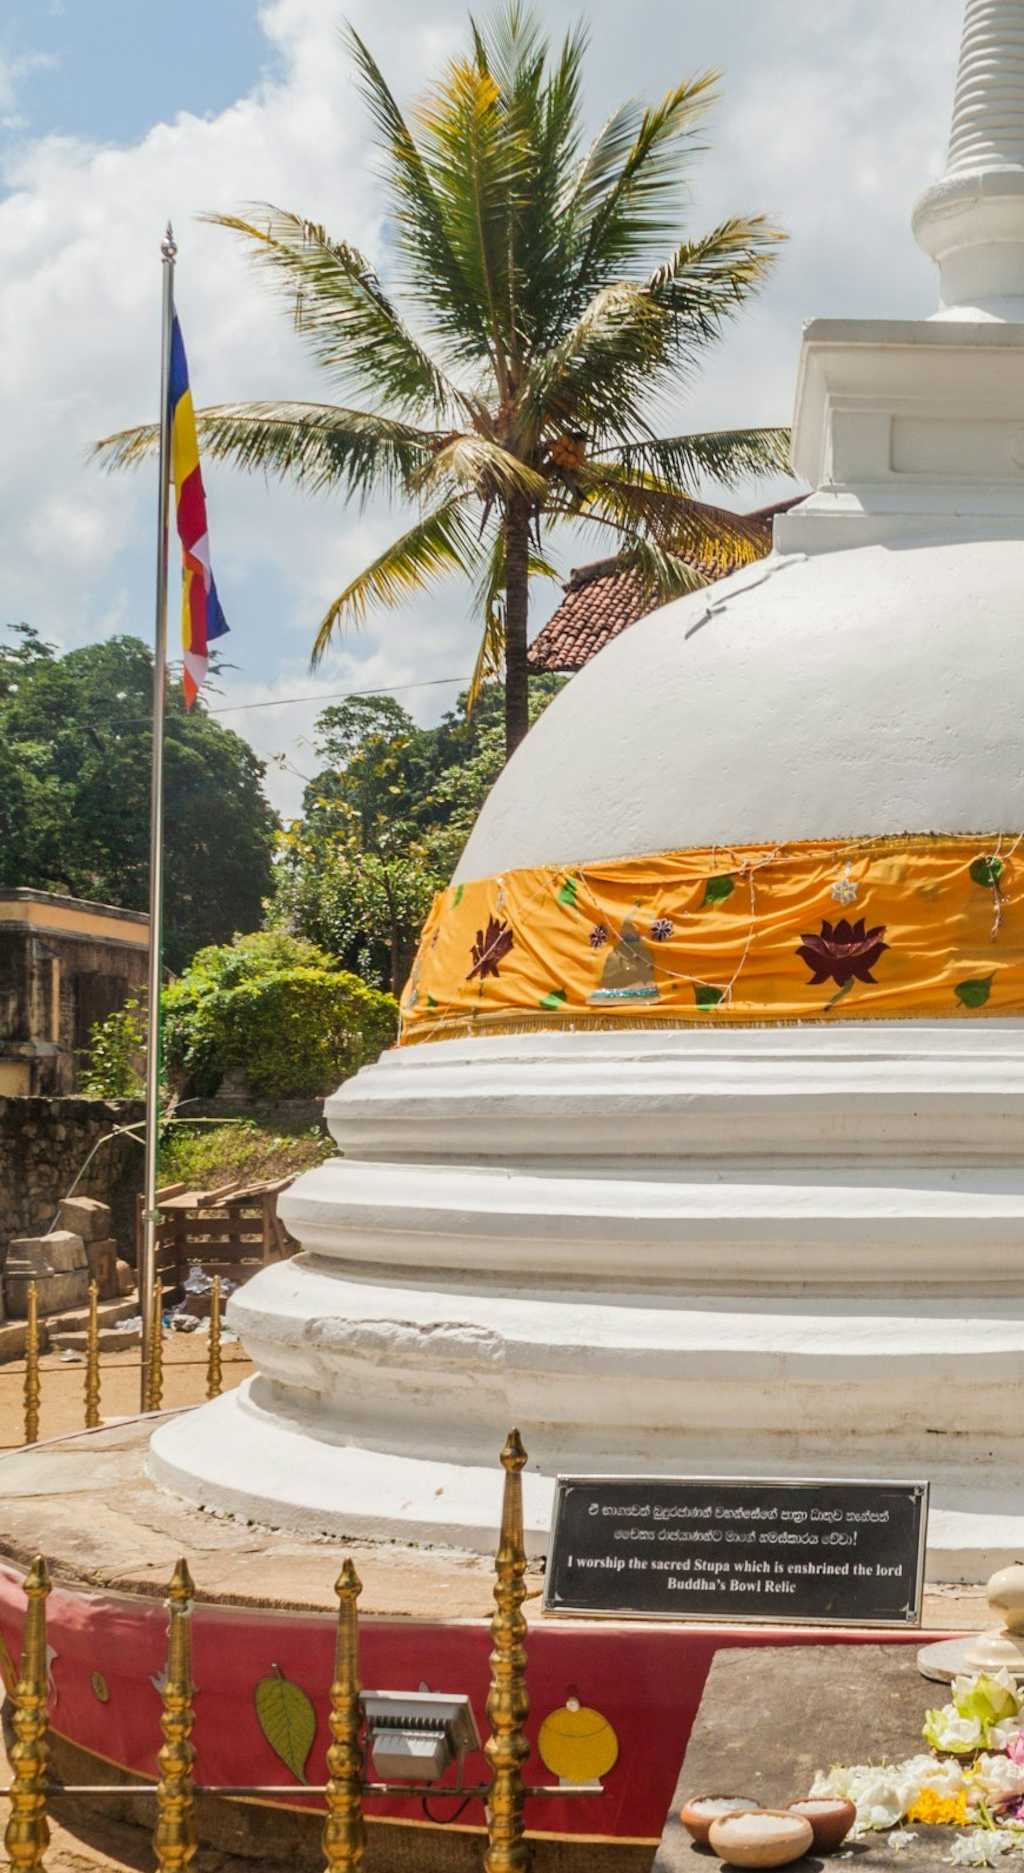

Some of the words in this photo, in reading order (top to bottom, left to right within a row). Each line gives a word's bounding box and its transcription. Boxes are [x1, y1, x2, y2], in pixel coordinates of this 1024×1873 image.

[567, 1555, 573, 1568] I
[577, 1556, 625, 1572] worship
[628, 1557, 647, 1570] the
[651, 1558, 690, 1571] sacred
[694, 1558, 730, 1575] Stupa
[734, 1560, 770, 1574] which
[774, 1561, 784, 1574] is
[787, 1561, 849, 1576] enshrined
[853, 1563, 873, 1576] the
[876, 1564, 903, 1577] lord
[667, 1577, 726, 1592] Buddha’s
[730, 1579, 761, 1592] Bowl
[765, 1580, 796, 1594] Relic
